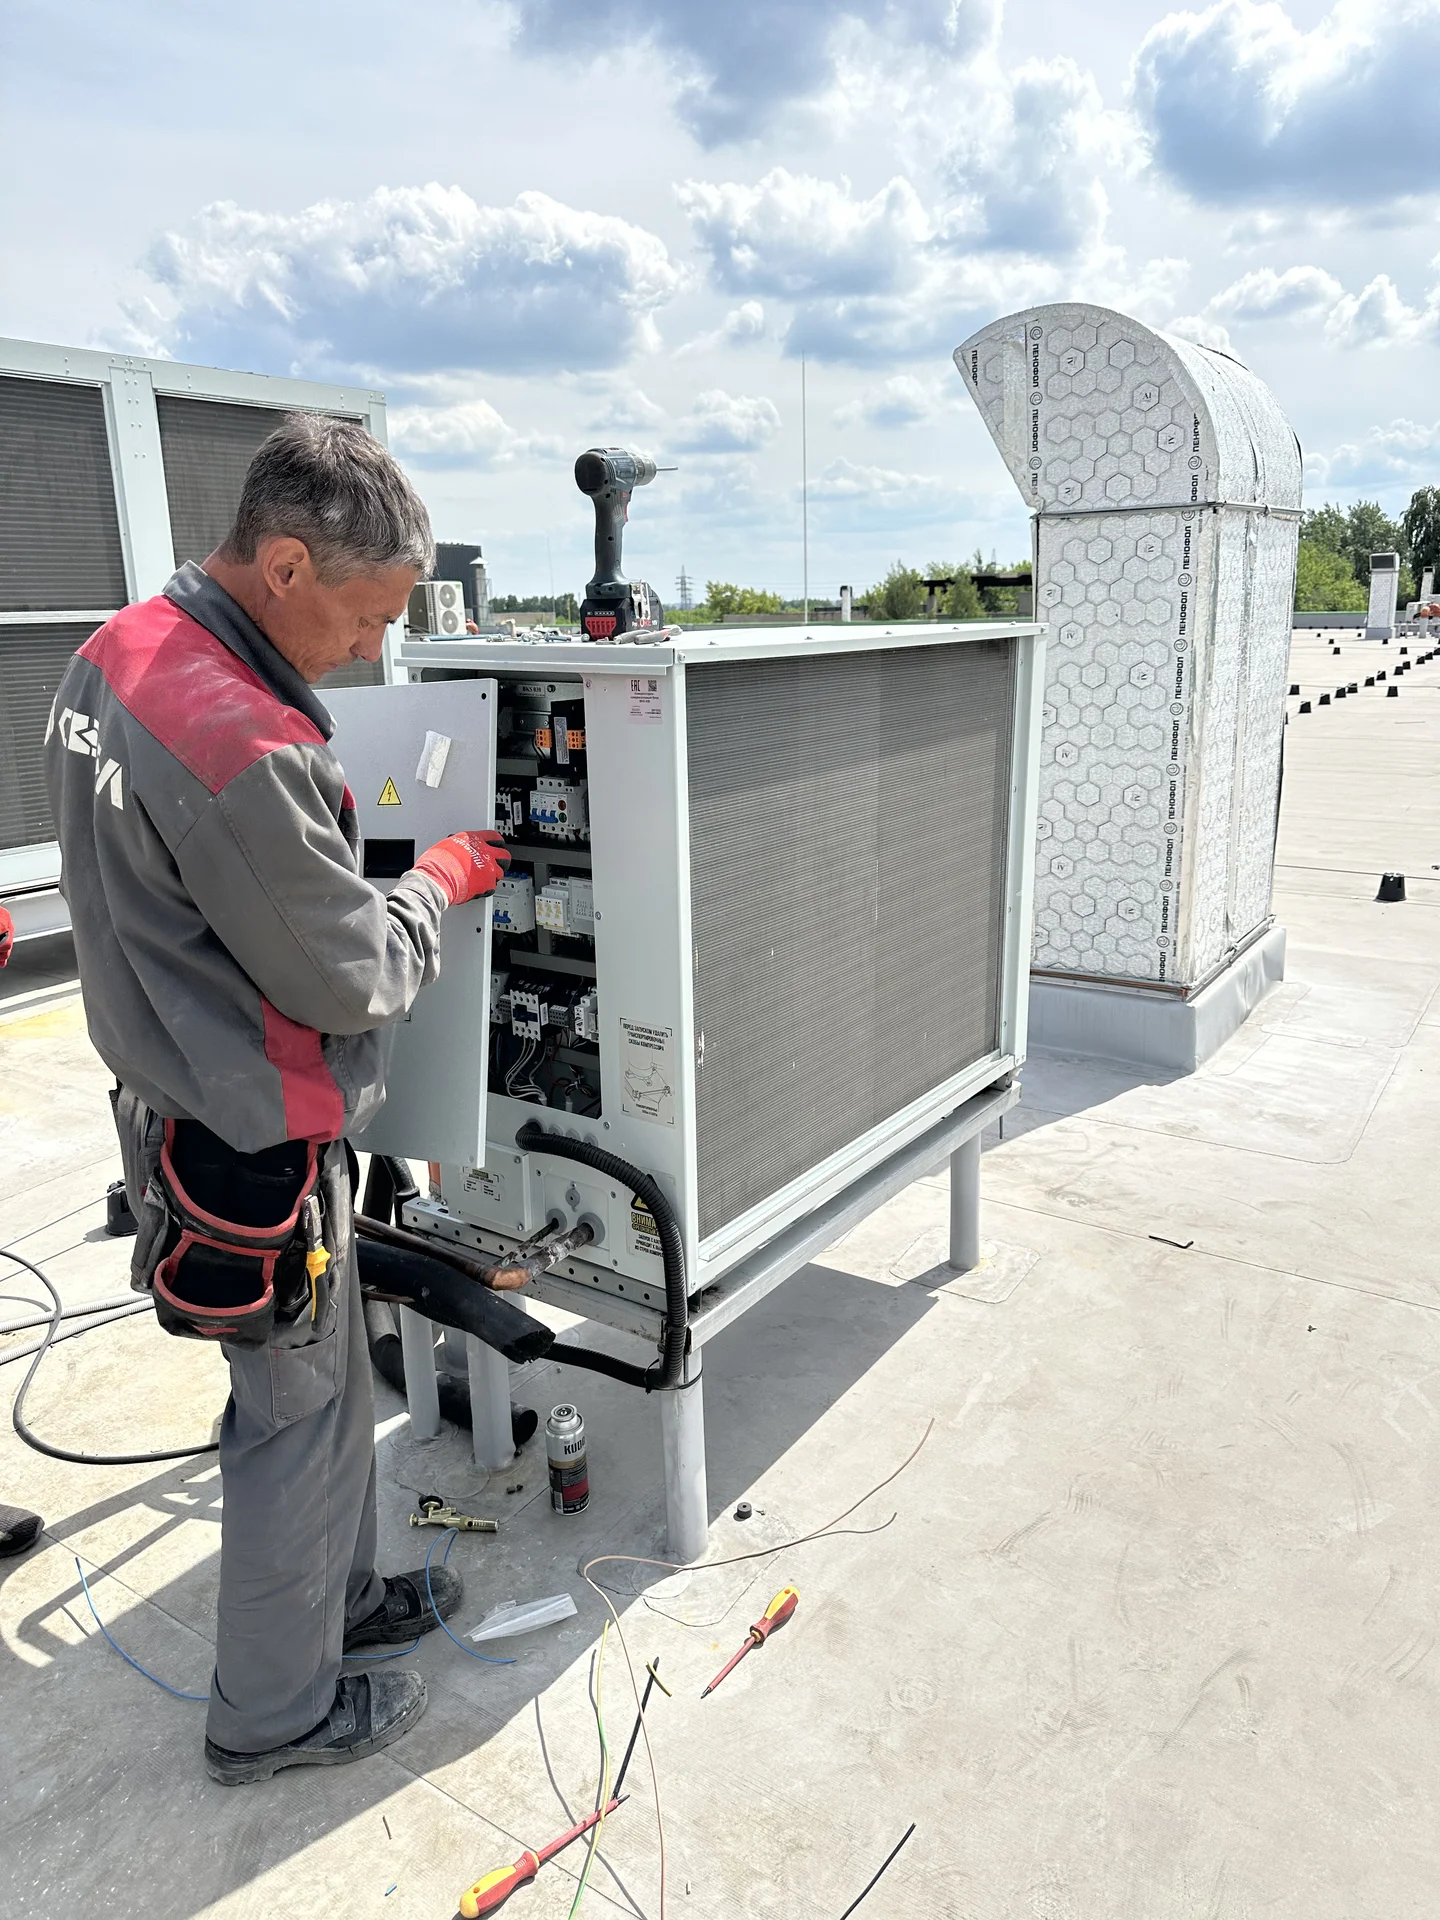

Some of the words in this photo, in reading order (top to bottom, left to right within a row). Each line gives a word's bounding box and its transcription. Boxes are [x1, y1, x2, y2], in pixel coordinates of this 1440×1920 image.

[1183, 525, 1192, 570] ПЕНОФОЛ
[1179, 591, 1188, 635] ПЕНОФОЛ
[630, 679, 641, 692] EAC
[1175, 656, 1184, 699] ПЕНОФОЛ
[1171, 719, 1180, 761] ПЕНОФОЛ
[1168, 780, 1177, 819] ПЕНОФОЛ
[1165, 838, 1174, 877] ПЕНОФОЛ
[1161, 895, 1170, 933] ПЕНОФОЛ
[631, 1212, 656, 1228] ВНИМА
[564, 1435, 586, 1455] KUDO
